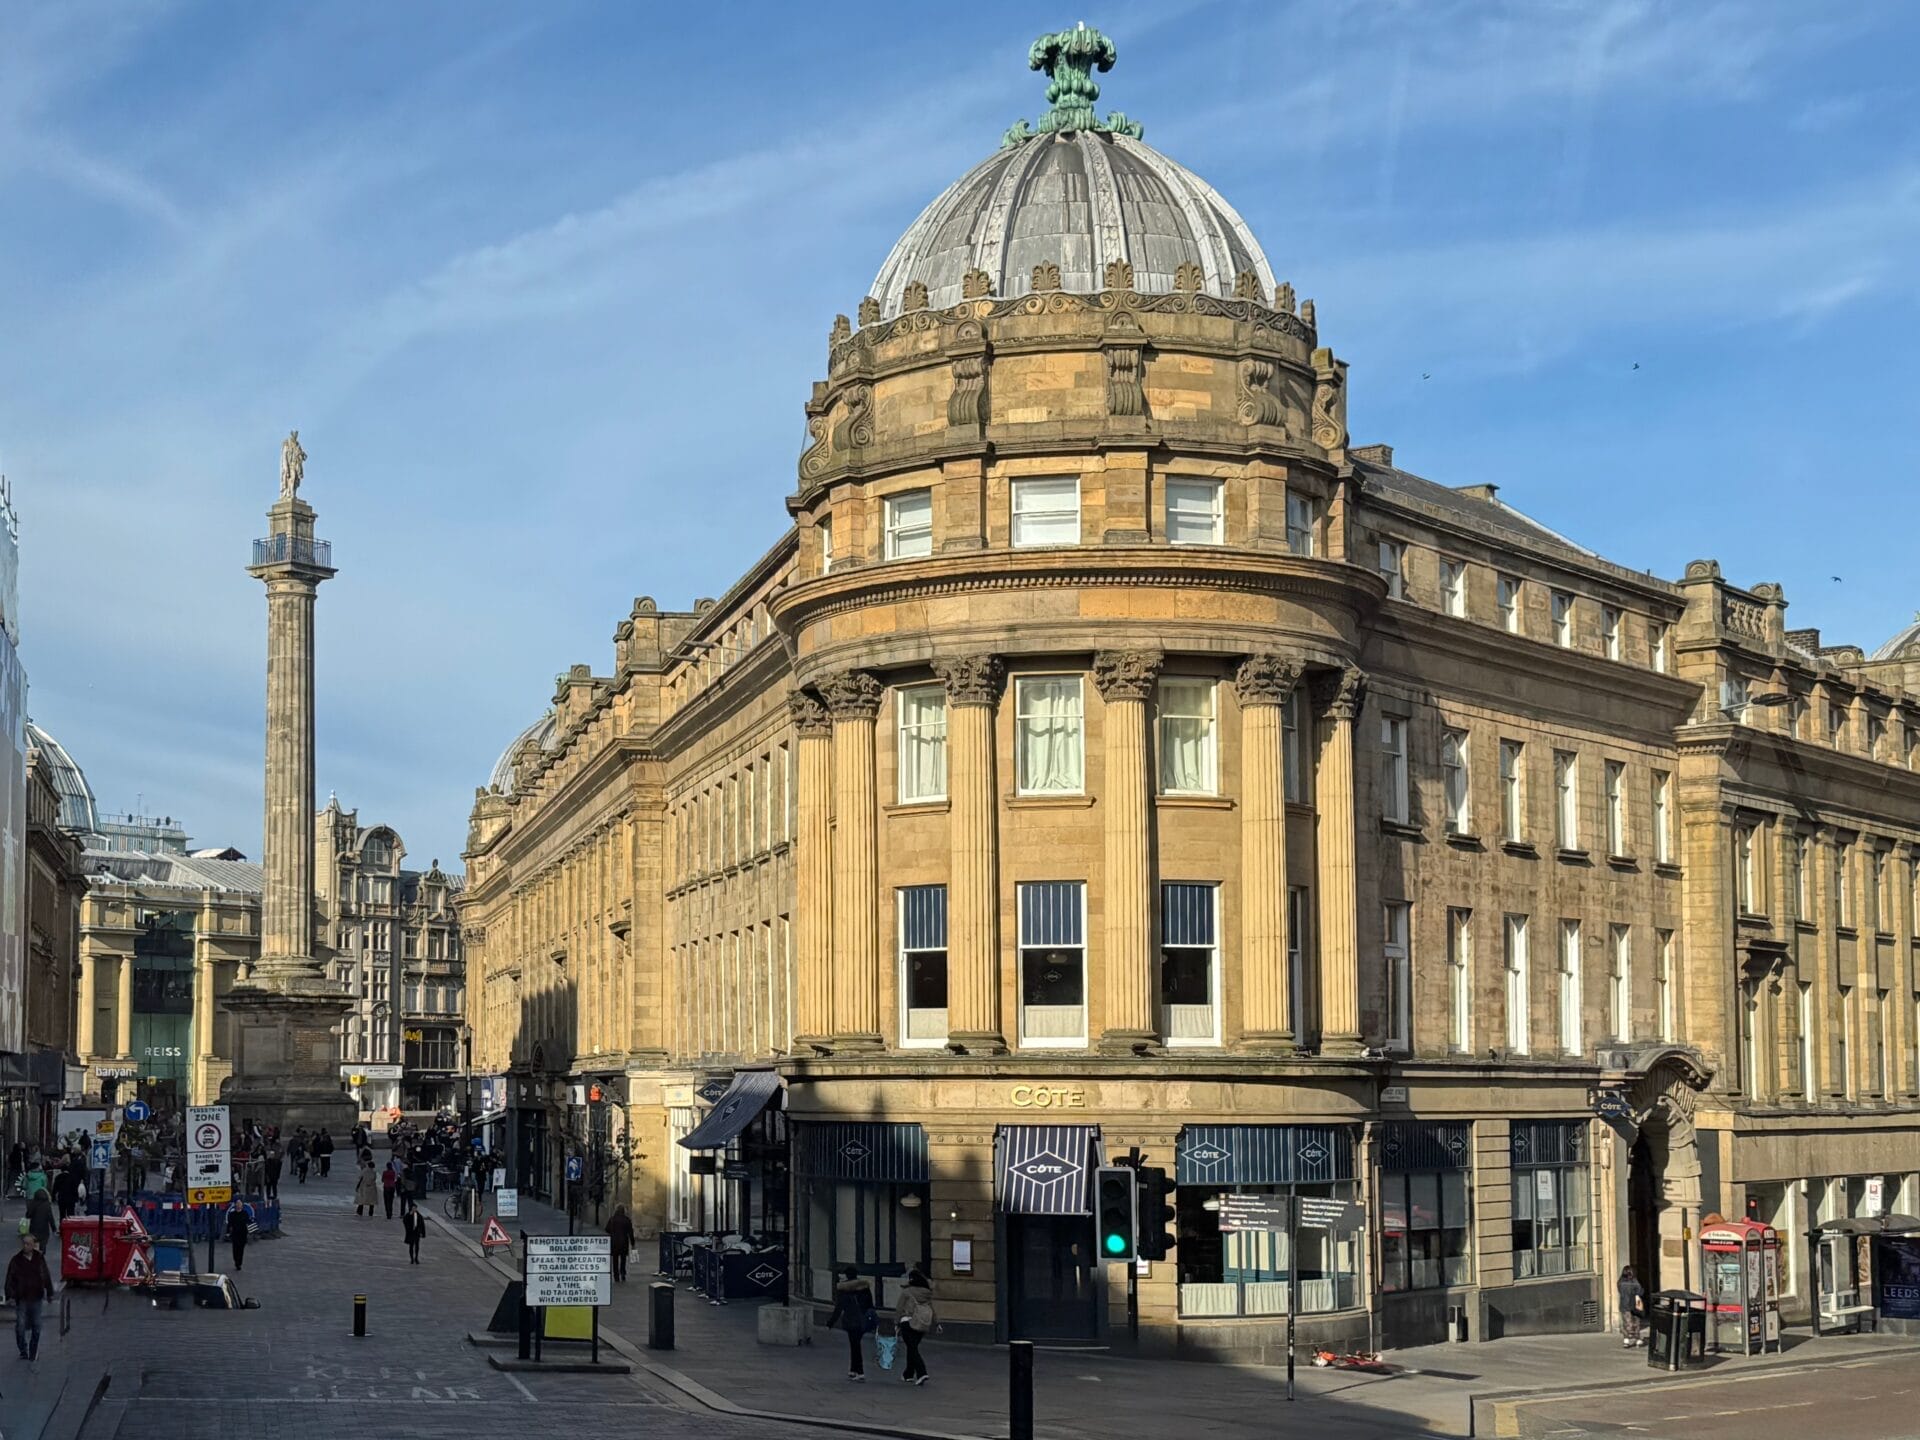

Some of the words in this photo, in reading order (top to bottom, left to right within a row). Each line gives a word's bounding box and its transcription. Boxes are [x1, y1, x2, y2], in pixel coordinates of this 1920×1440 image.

[144, 1047, 181, 1056] REISS
[95, 1066, 132, 1079] banyan
[1010, 1085, 1085, 1107] CÔTE
[195, 1113, 221, 1121] ZONE
[1193, 1150, 1220, 1159] CÔTE
[1026, 1164, 1062, 1174] CÔTE
[1883, 1288, 1920, 1298] LEEDS
